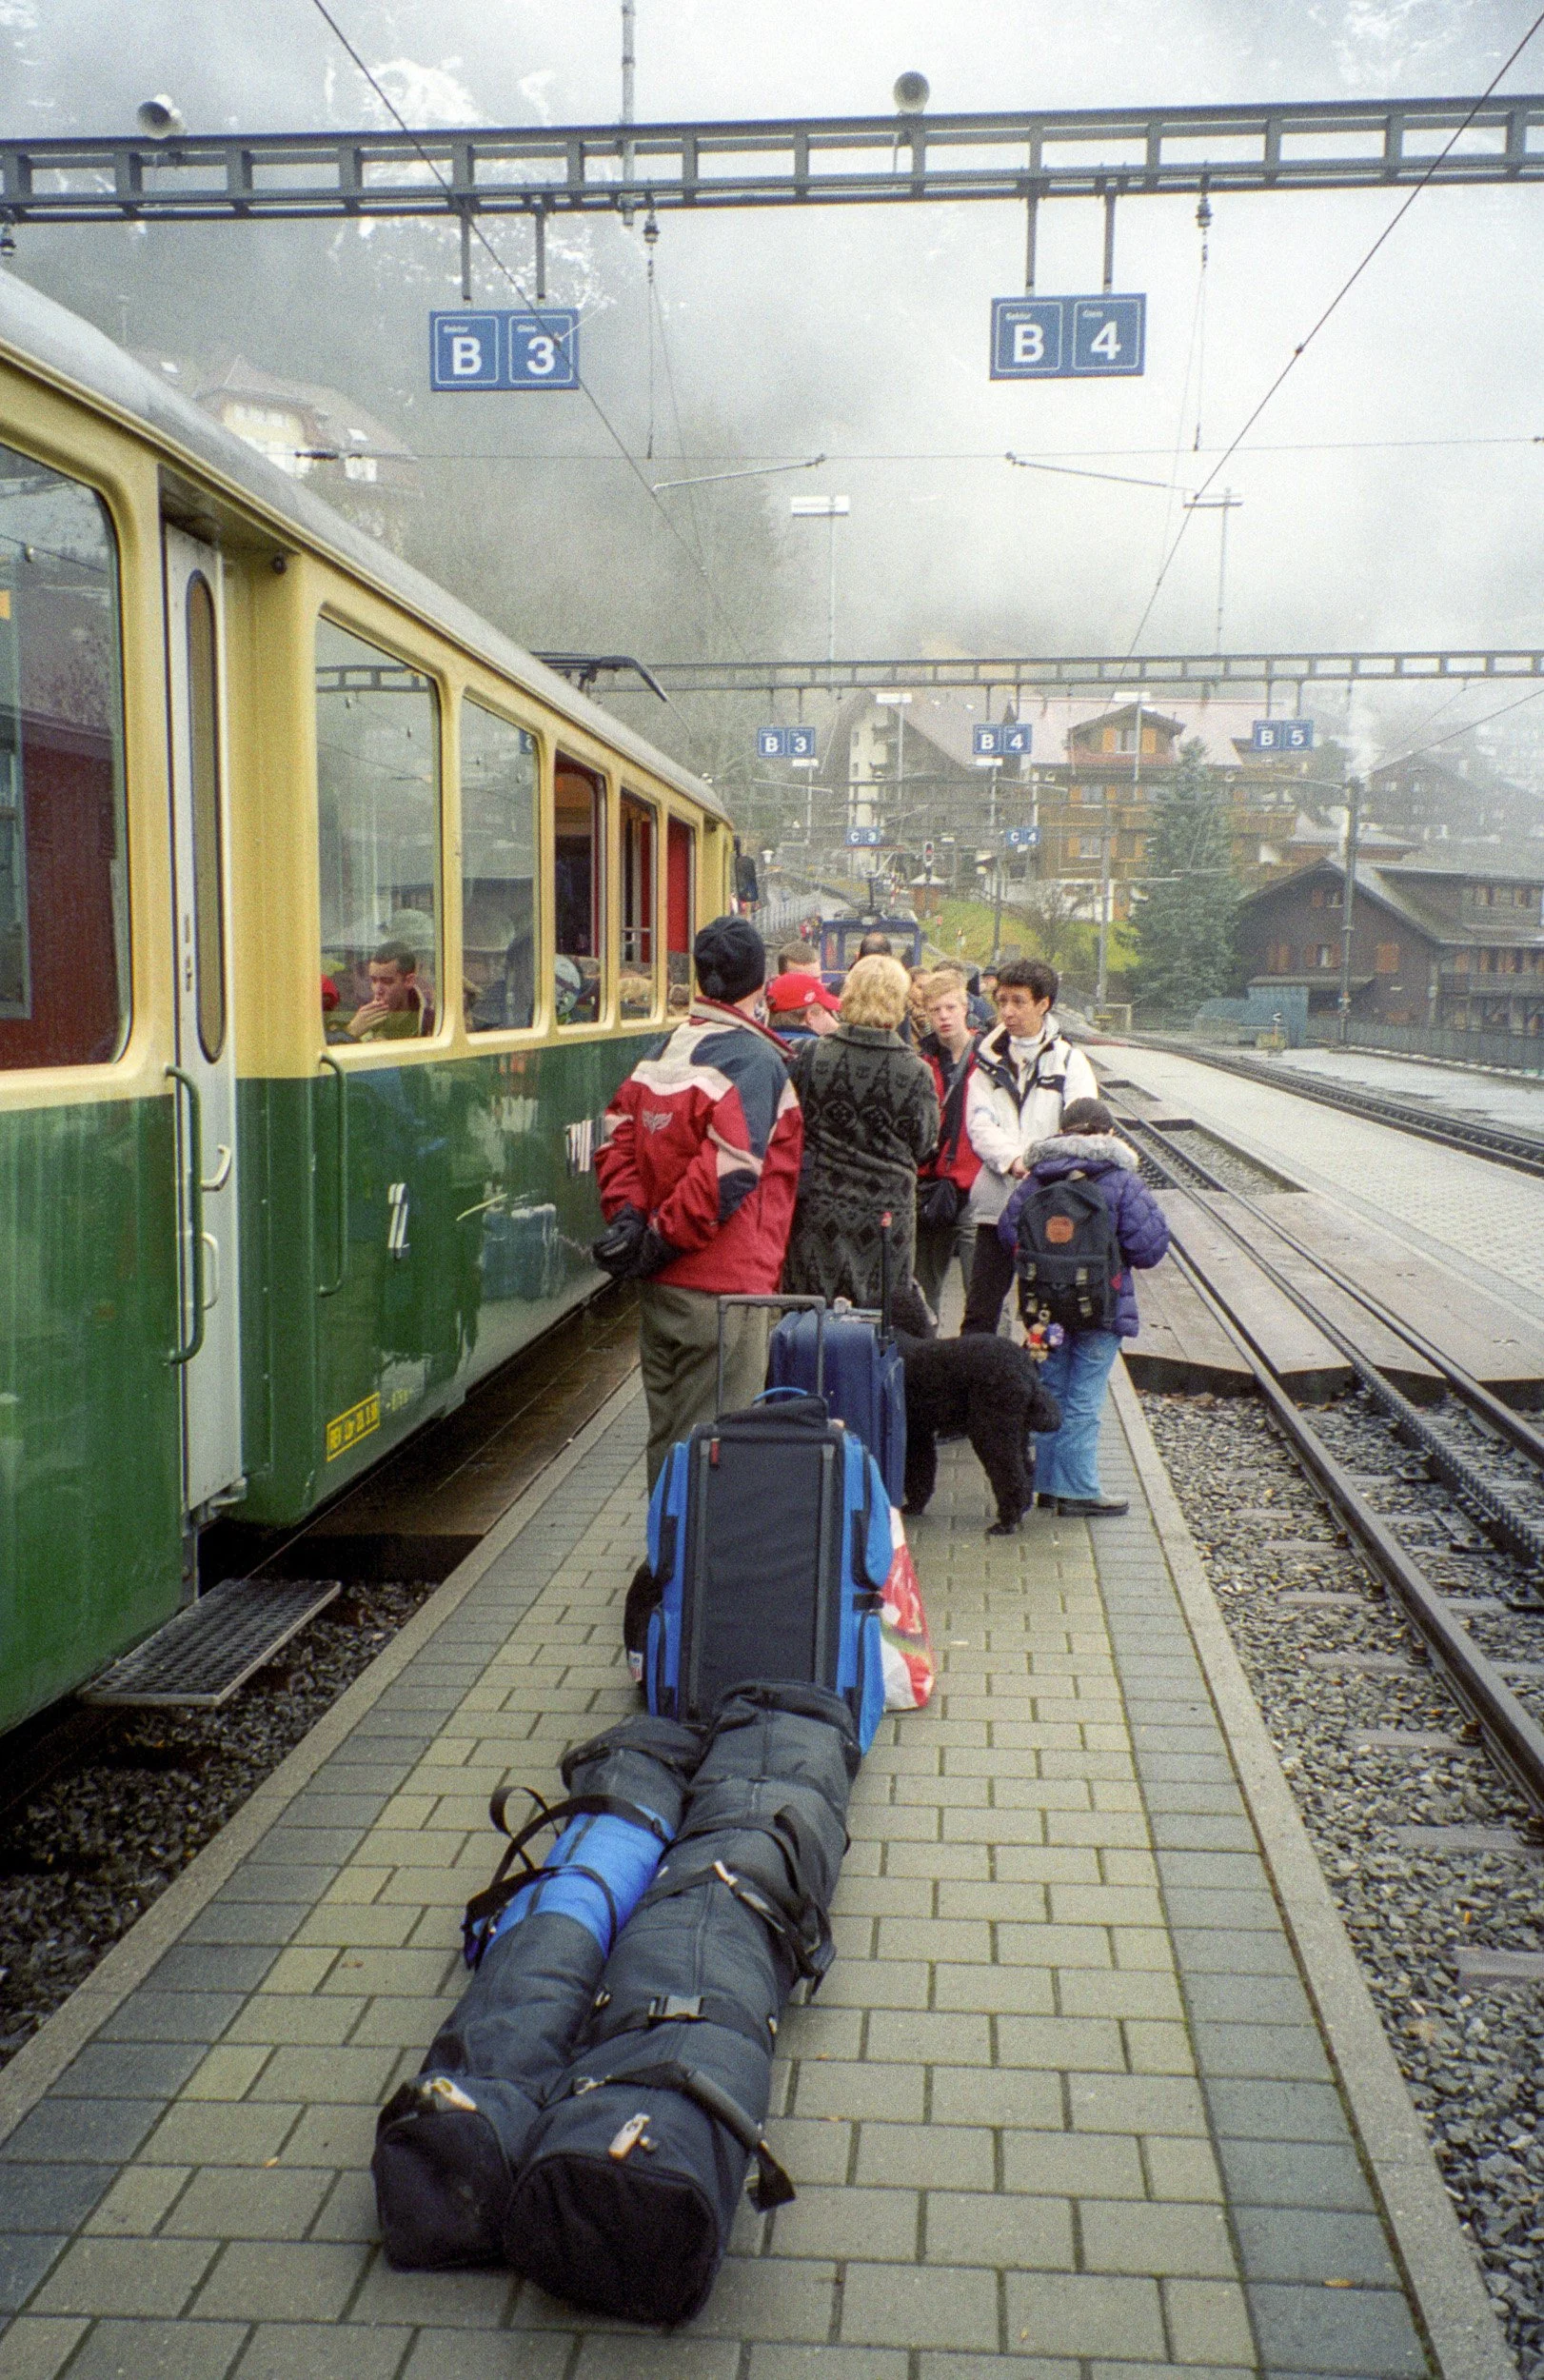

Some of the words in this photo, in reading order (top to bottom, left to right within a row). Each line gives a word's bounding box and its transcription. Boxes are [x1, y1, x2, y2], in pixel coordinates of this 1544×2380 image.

[1013, 323, 1044, 364] B
[1090, 320, 1122, 361] 4
[452, 336, 483, 375] B
[526, 335, 556, 375] 3
[764, 736, 779, 753] B
[794, 736, 807, 753] 3
[980, 733, 995, 750] B
[1010, 733, 1023, 750] 4
[1260, 729, 1275, 746] B
[1291, 729, 1304, 745] 5
[850, 831, 860, 843] C
[1010, 831, 1019, 843] C
